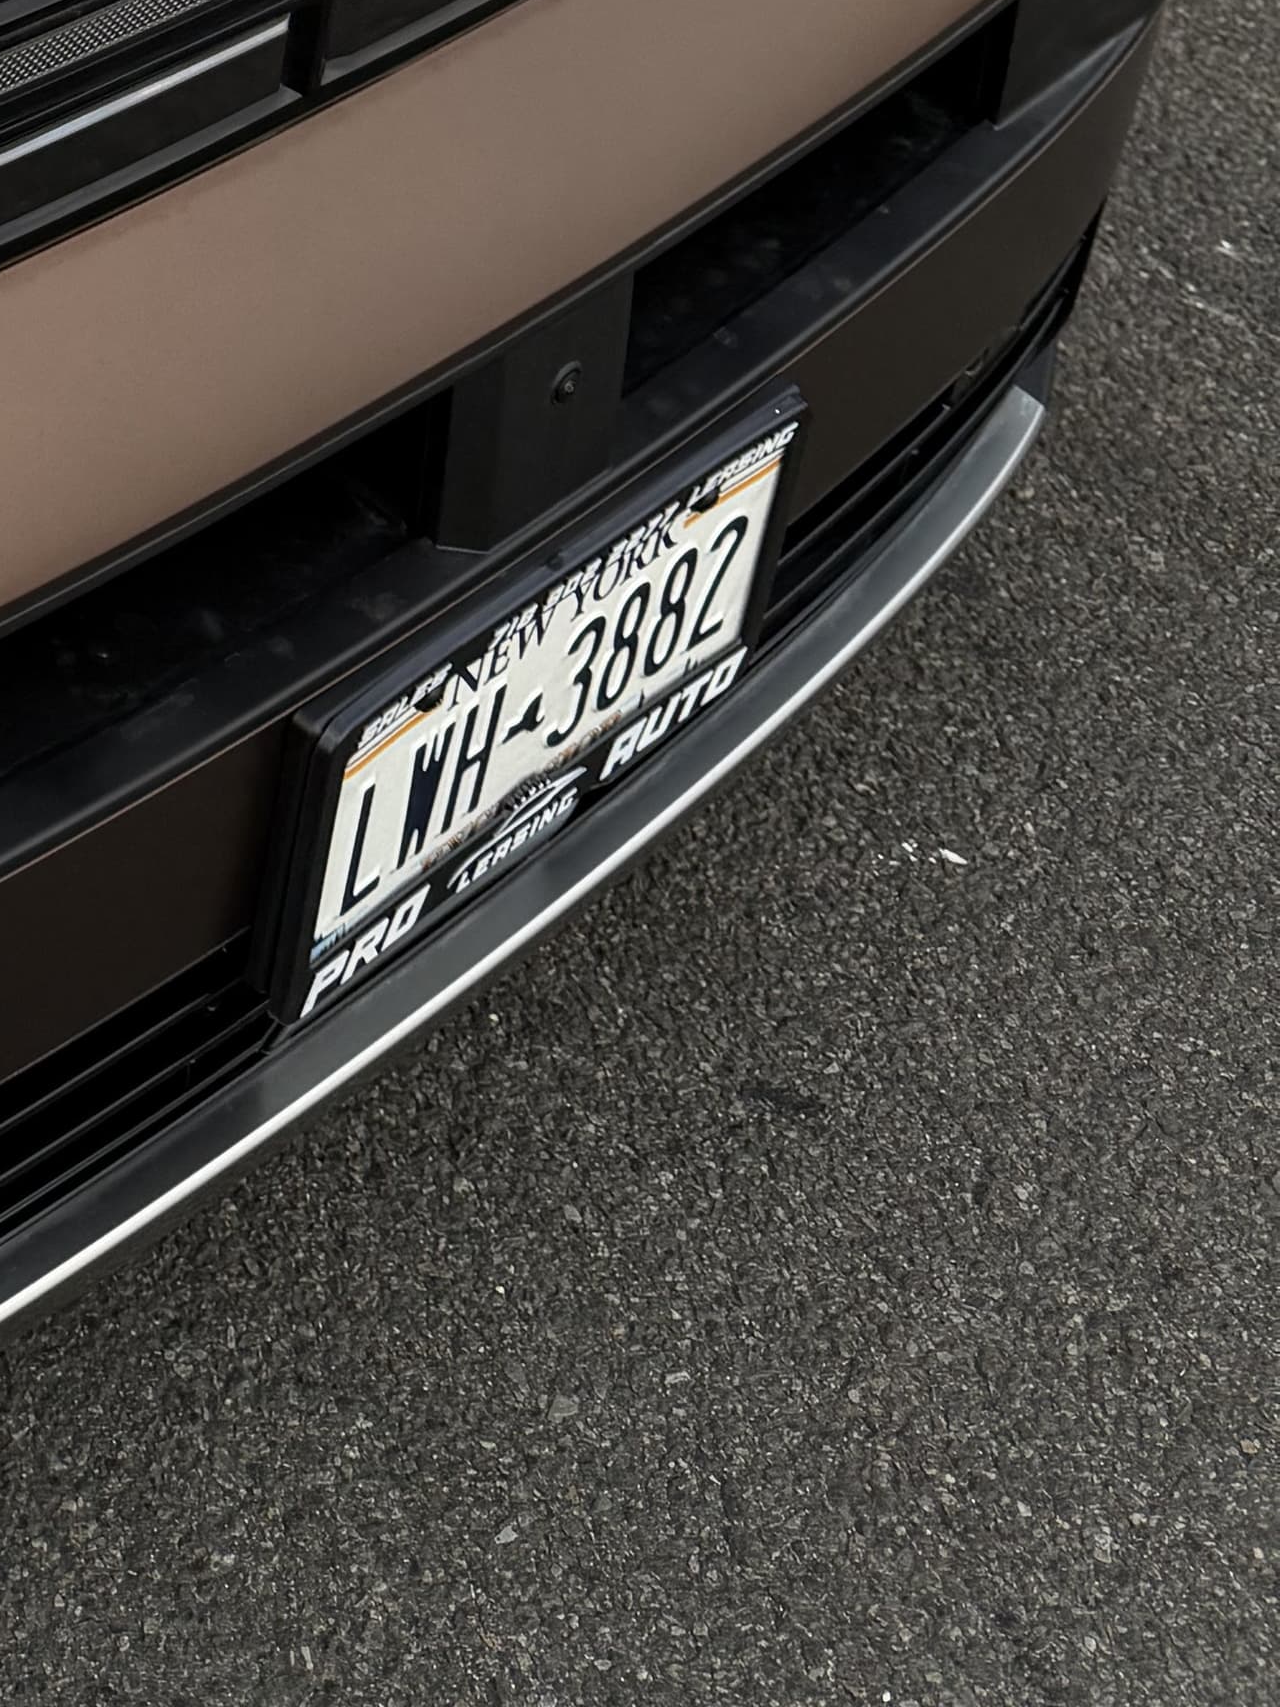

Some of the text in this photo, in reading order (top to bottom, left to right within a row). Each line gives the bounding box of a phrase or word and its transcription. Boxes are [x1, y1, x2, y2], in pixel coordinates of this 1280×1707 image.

[339, 514, 750, 918] LWH 3882
[357, 662, 453, 751] SALES
[686, 421, 800, 509] LEASING
[447, 515, 679, 712] NEW YORK
[299, 646, 748, 1020] PRO AUTO
[455, 787, 578, 894] LEASING
